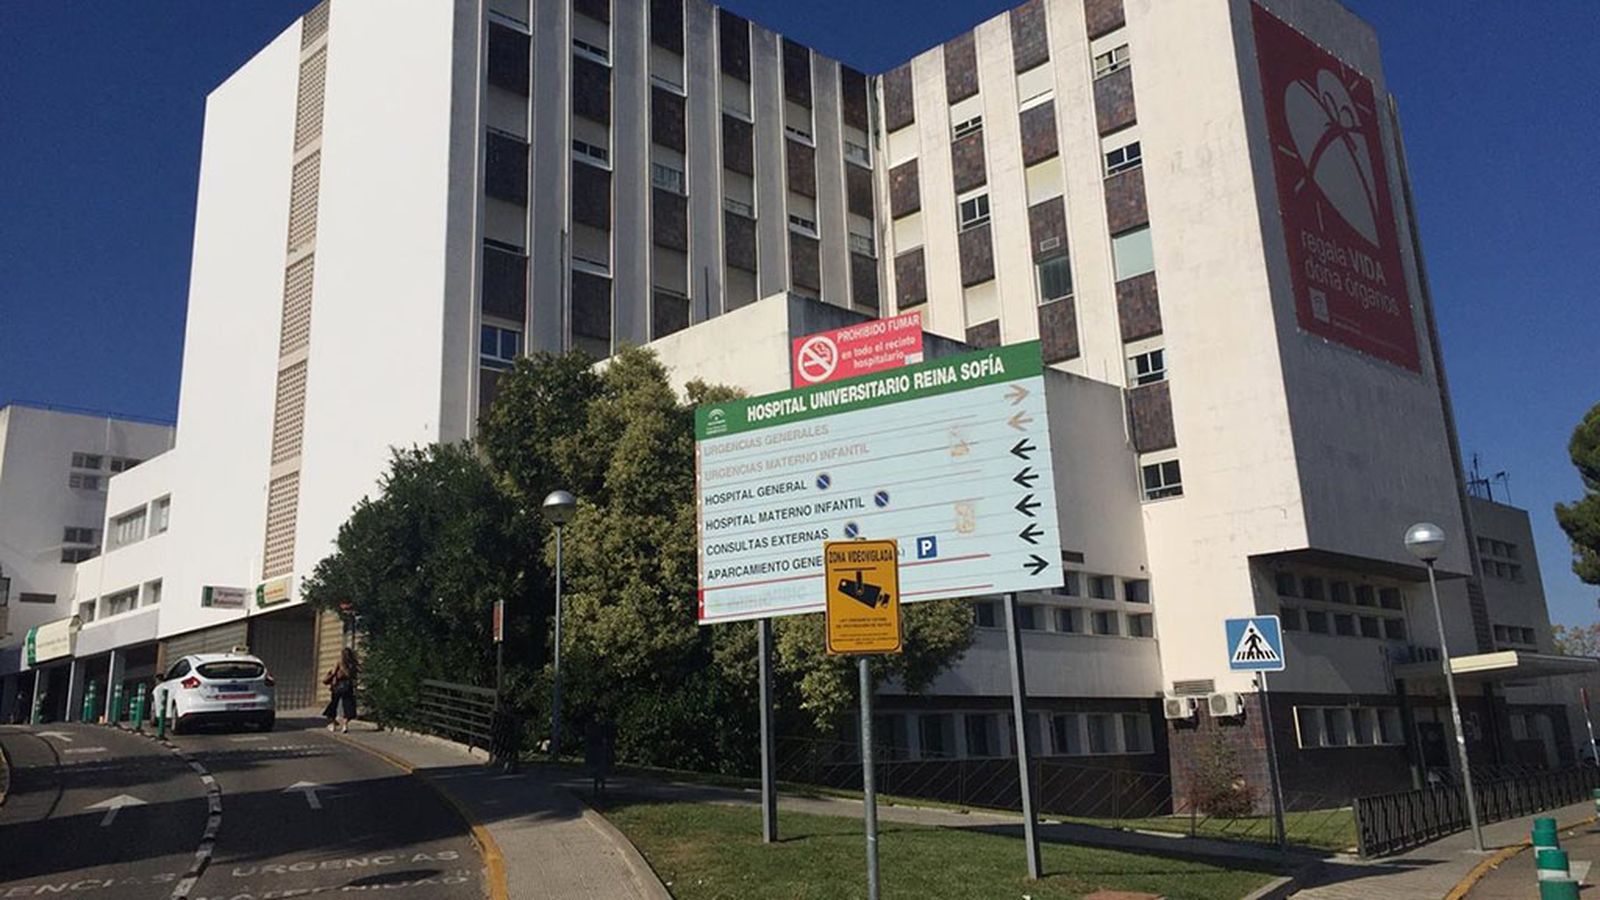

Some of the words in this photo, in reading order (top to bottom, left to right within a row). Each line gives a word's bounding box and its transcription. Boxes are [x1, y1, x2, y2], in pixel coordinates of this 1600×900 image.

[1301, 230, 1347, 267] regala
[1347, 246, 1387, 286] VIDA
[1304, 254, 1342, 291] dona
[1345, 271, 1400, 316] órganos
[837, 324, 886, 343] PROHIBIDO
[888, 314, 920, 331] FUMAR
[841, 351, 852, 360] en
[854, 345, 873, 357] todo
[875, 342, 884, 352] el
[885, 335, 916, 350] recinto
[853, 350, 904, 369] hospitalario
[747, 395, 807, 422] HOSPITAL
[810, 375, 910, 410] UNIVERSITARIO
[914, 366, 957, 389] REINA
[961, 353, 1005, 381] SOFÍA
[704, 436, 762, 457] URGENCIAS
[765, 425, 829, 445] GENERALES
[705, 461, 763, 481] URGENCIAS
[766, 451, 817, 470] MATERNO
[820, 443, 869, 458] INFANTIL
[705, 489, 754, 505] HOSPITAL
[757, 481, 807, 497] GENERAL
[705, 514, 756, 531] HOSPITAL
[758, 505, 812, 522] MATERNO
[814, 497, 865, 513] INFANTIL
[706, 537, 768, 556] CONSULTAS
[771, 529, 829, 546] EXTERNAS
[829, 551, 845, 563] ZONA
[707, 560, 790, 580] APARCAMIENTO
[792, 555, 823, 569] GENE
[921, 540, 932, 556] P
